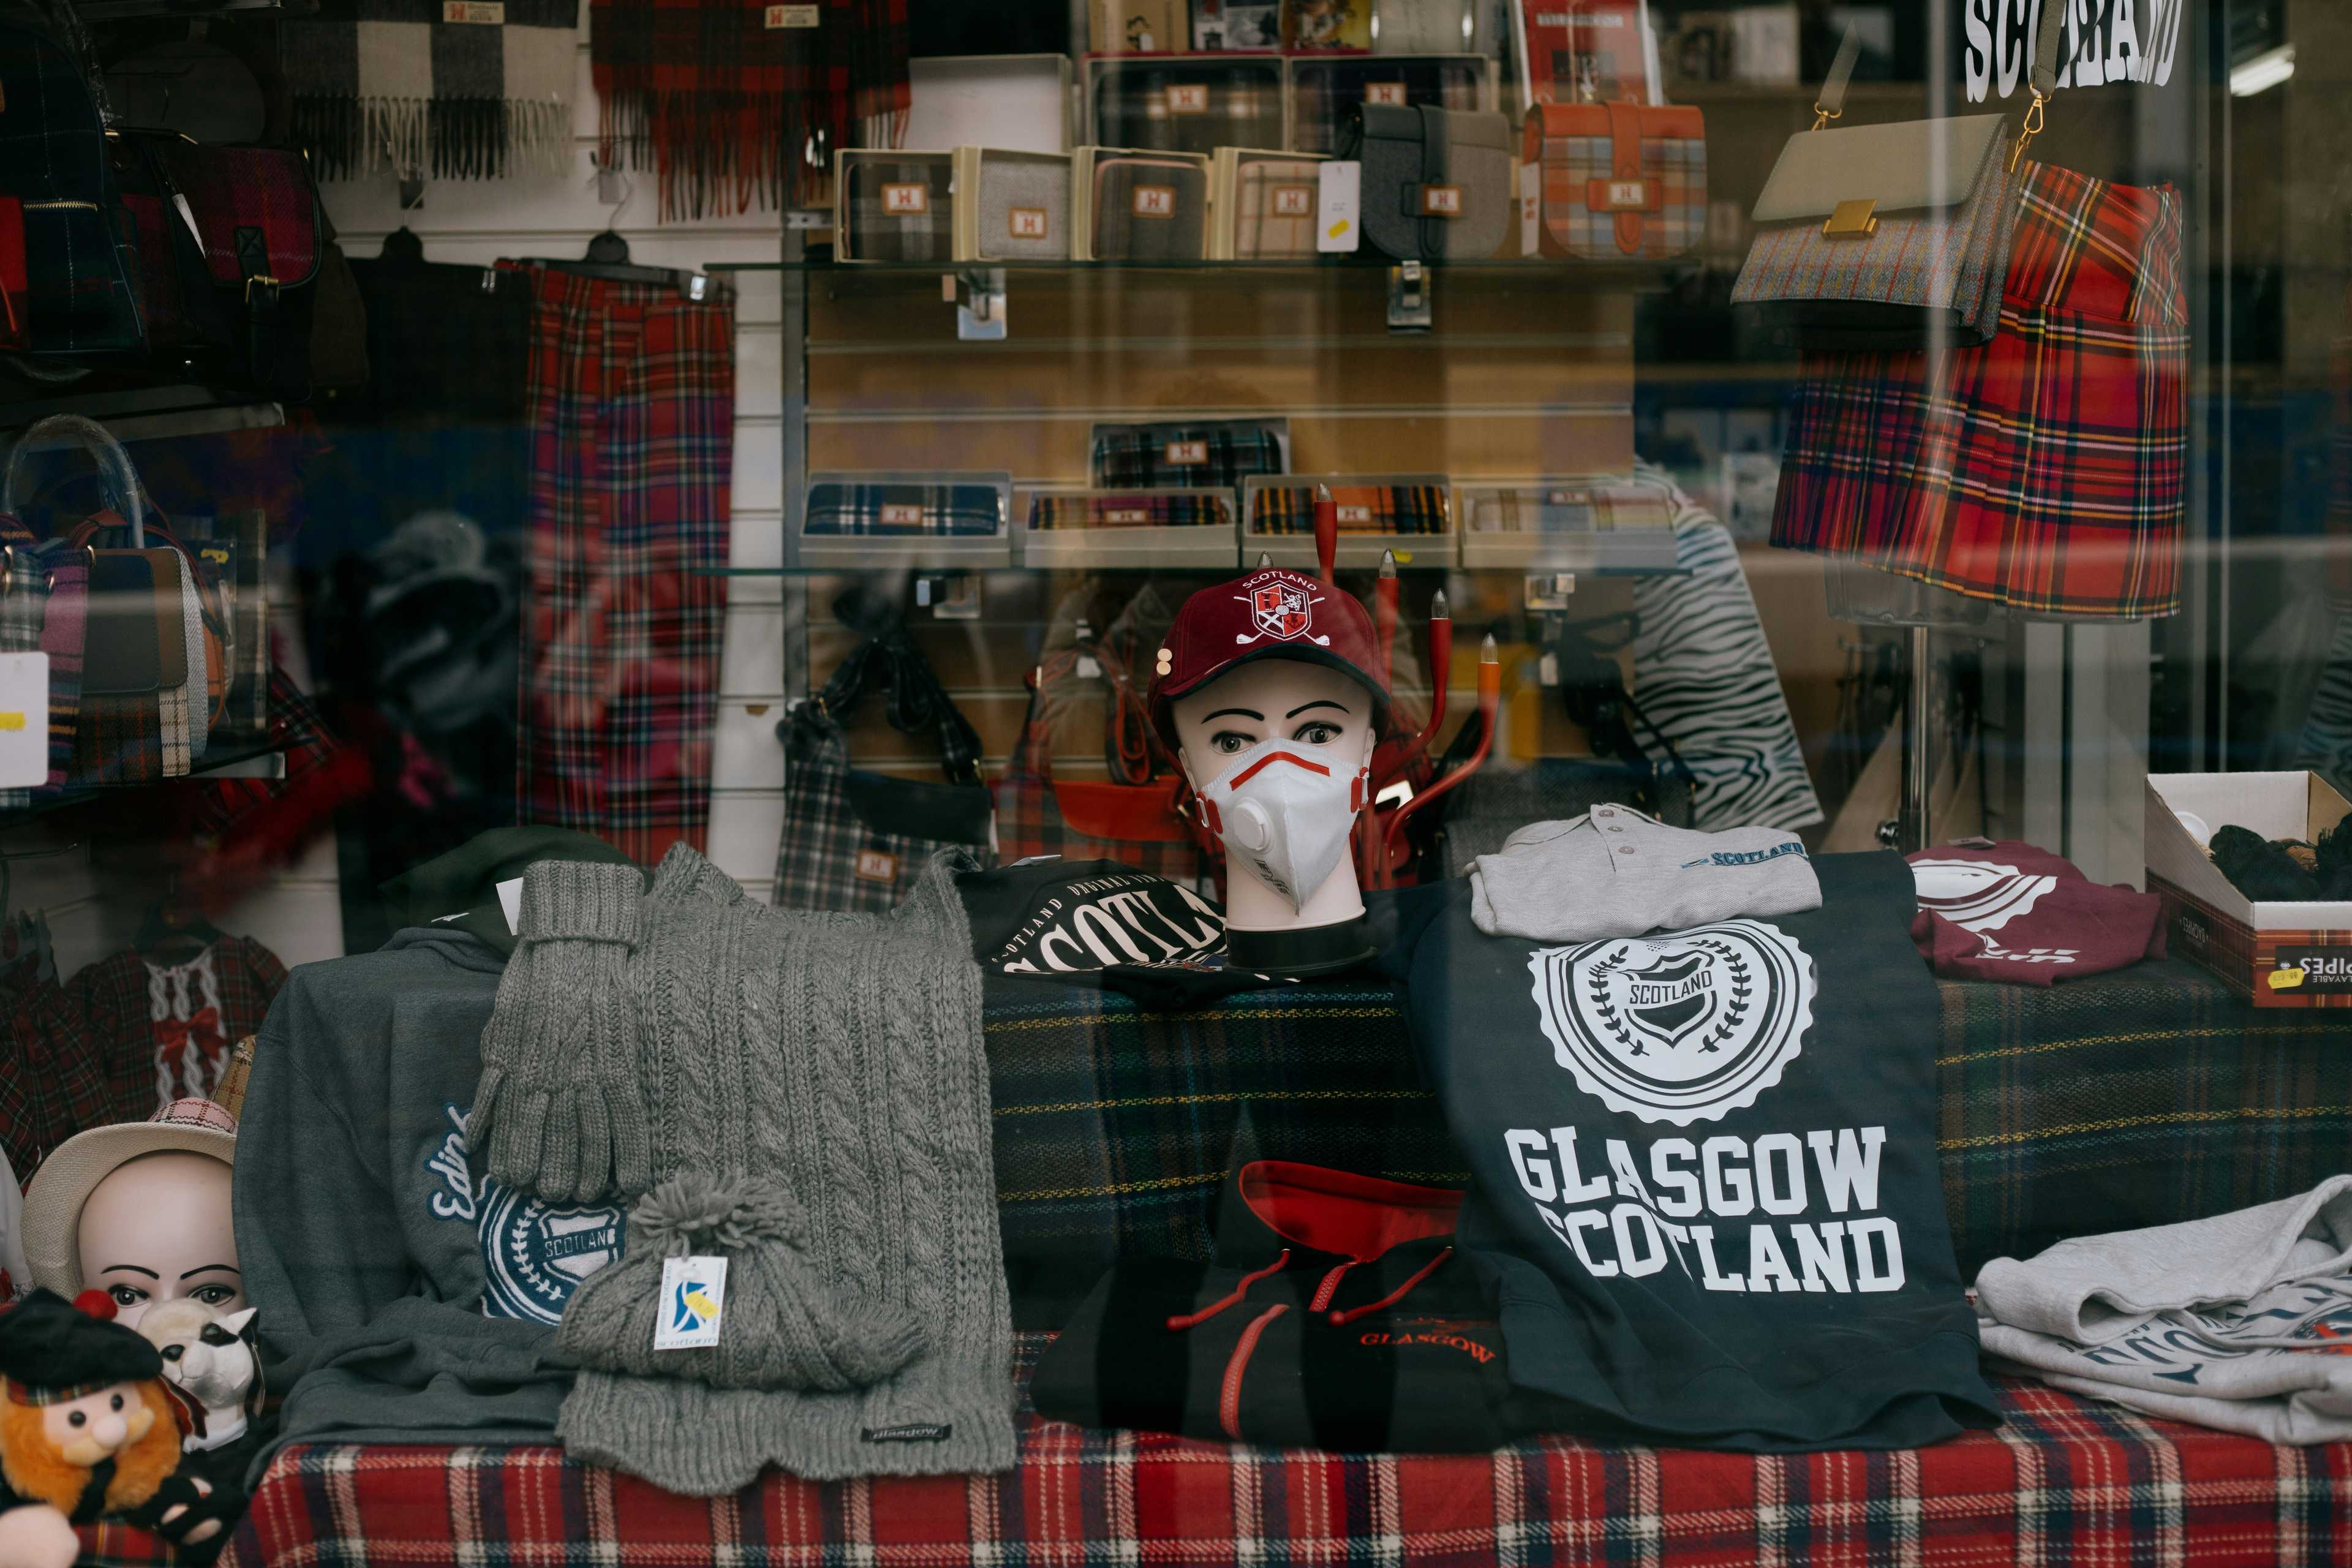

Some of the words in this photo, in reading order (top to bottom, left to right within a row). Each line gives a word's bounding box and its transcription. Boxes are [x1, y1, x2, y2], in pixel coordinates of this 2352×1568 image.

[1243, 571, 1316, 590] SCOTLAND
[1711, 842, 1805, 865] SCOTLAND
[1629, 970, 1713, 1005] SCOTLAND
[1504, 1126, 1887, 1217] GLASGOW
[1360, 1333, 1496, 1363] GLASGOW
